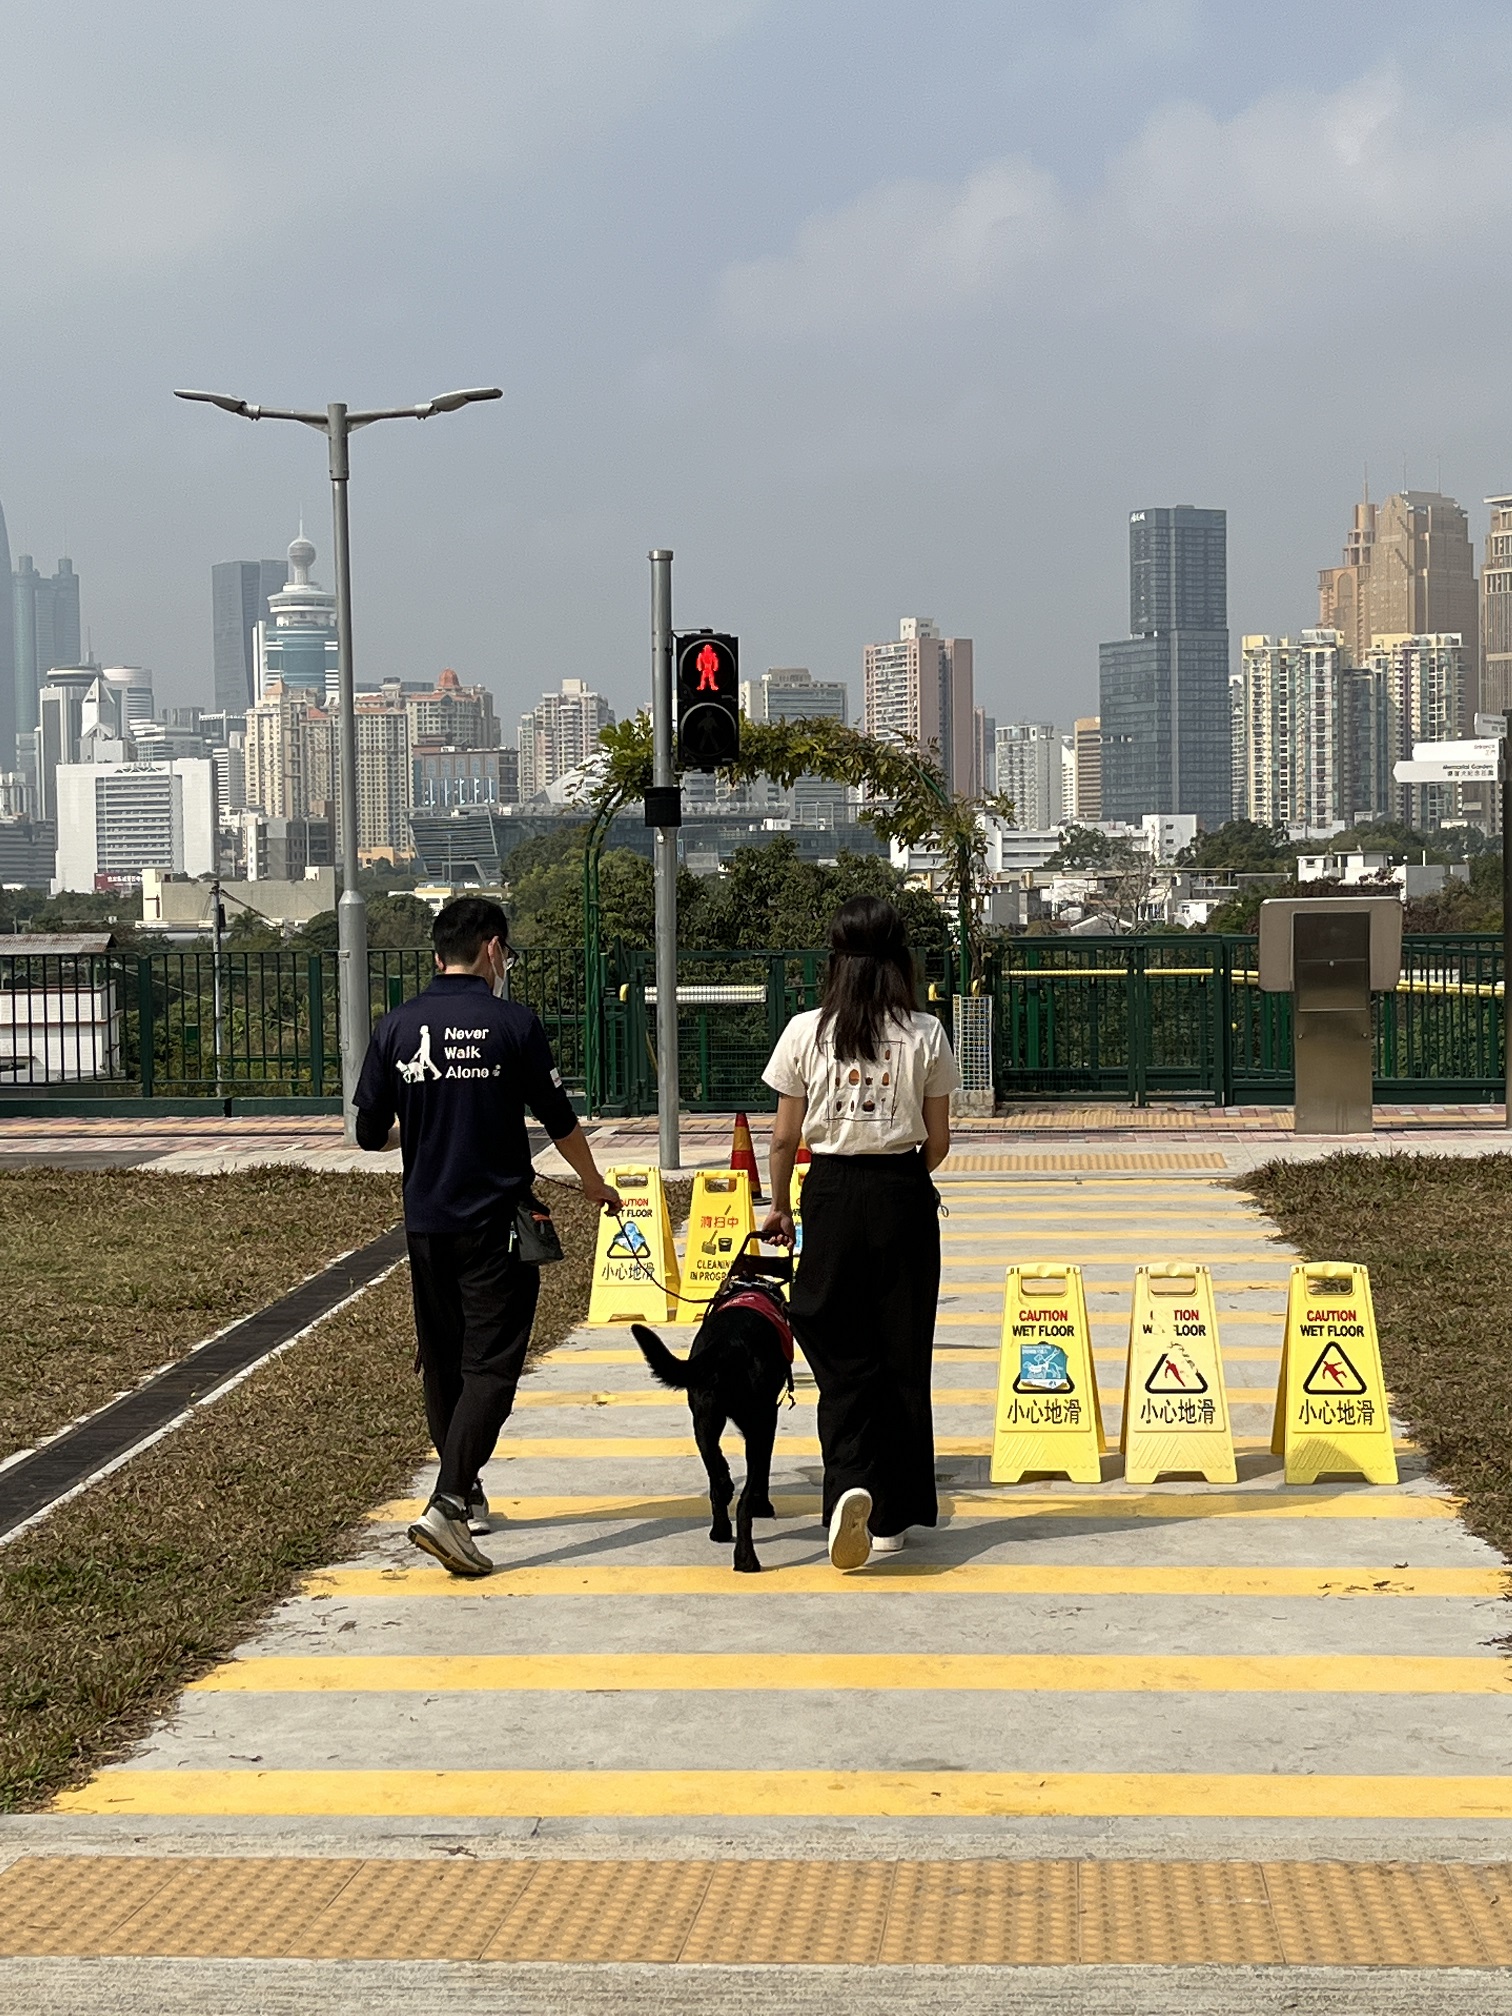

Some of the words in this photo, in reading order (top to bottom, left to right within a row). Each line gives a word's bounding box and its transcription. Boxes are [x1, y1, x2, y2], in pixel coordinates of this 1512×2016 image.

[444, 1027, 489, 1040] Never
[444, 1046, 481, 1059] Walk
[445, 1065, 489, 1079] Alone
[620, 1198, 649, 1207] UTION
[627, 1209, 653, 1218] FLOOR
[696, 1259, 735, 1270] CLEANIN
[601, 1262, 655, 1281] 小心地滑
[690, 1271, 698, 1281] IN
[699, 1271, 728, 1281] PROGR
[1019, 1309, 1068, 1322] CAUTION
[1306, 1309, 1357, 1322] CAUTION
[1012, 1325, 1036, 1337] WET
[1038, 1325, 1075, 1337] FLOOR
[1299, 1324, 1325, 1337] WET
[1327, 1324, 1365, 1337] FLOOR
[1007, 1397, 1082, 1425] 小心地滑
[1140, 1397, 1216, 1425] 小心地滑
[1298, 1398, 1375, 1426] 小心地滑
